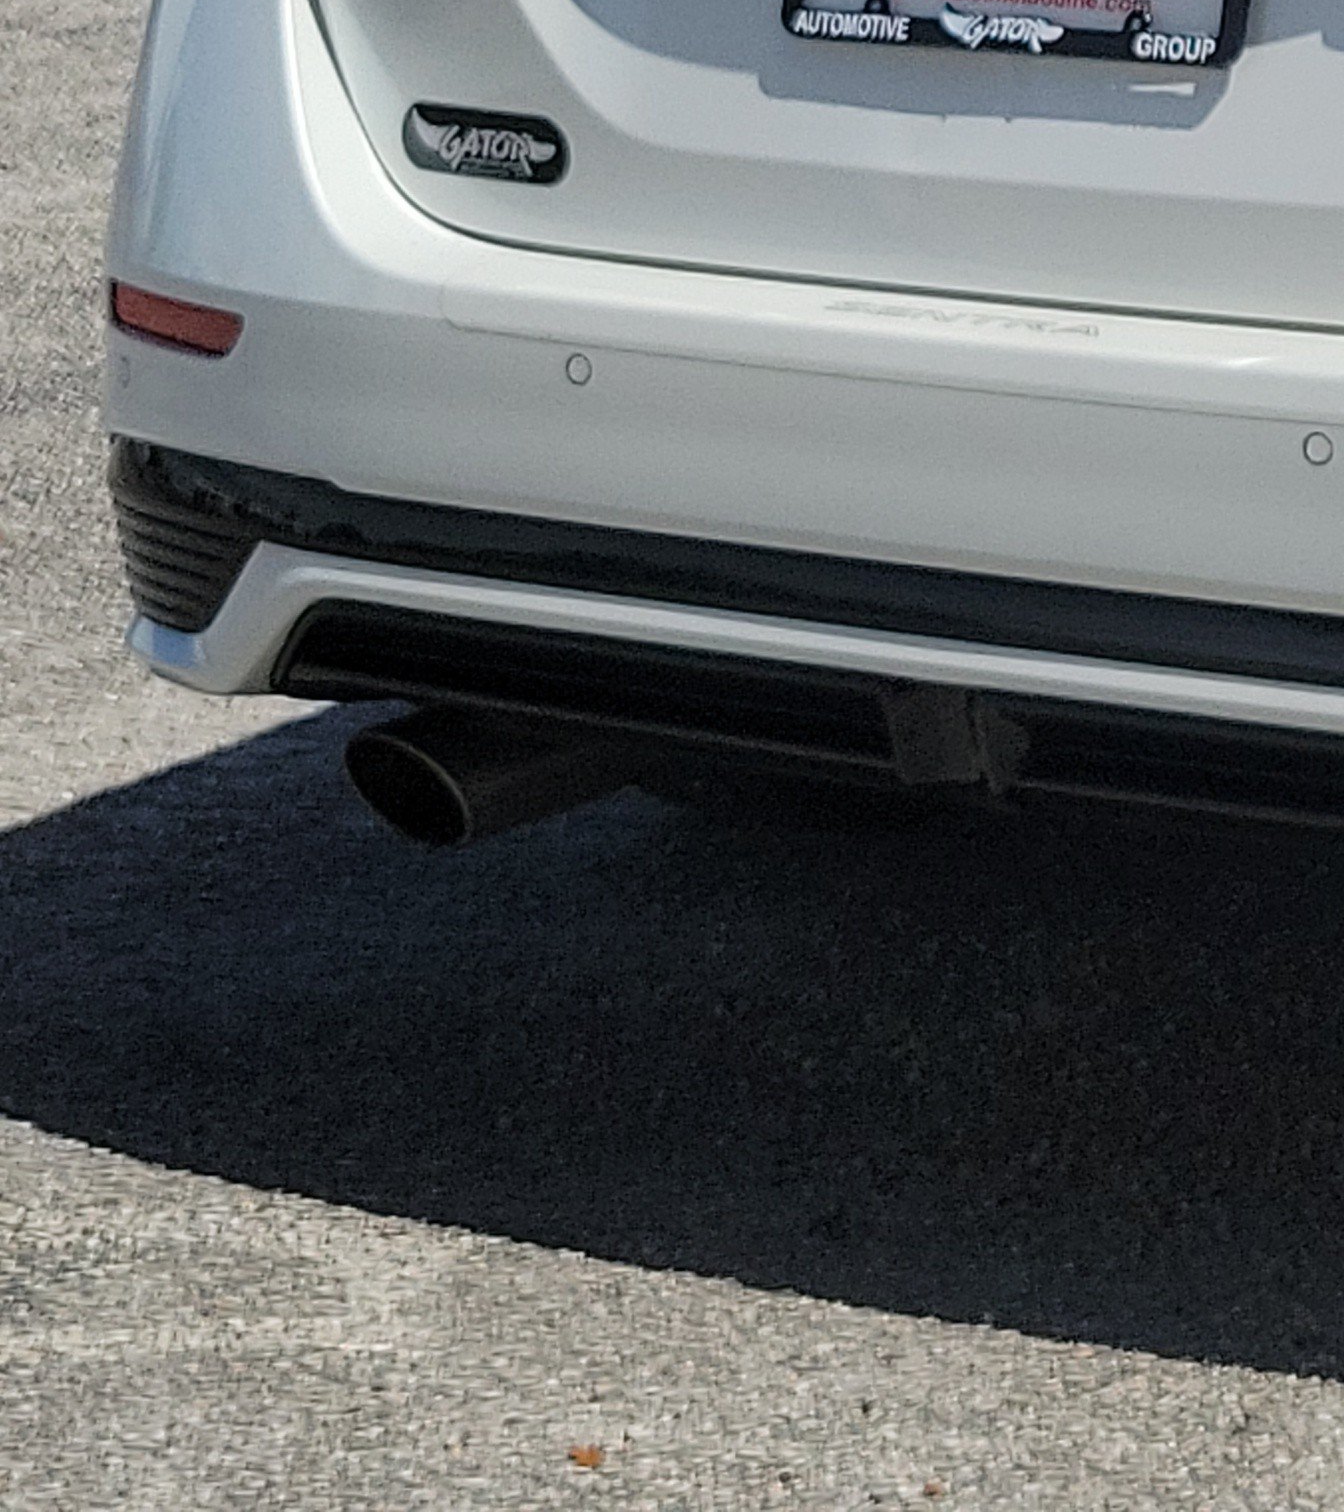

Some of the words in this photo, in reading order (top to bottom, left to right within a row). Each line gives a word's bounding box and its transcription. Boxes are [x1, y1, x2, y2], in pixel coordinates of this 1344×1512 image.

[793, 8, 911, 42] AUTOMOTIVE
[1131, 31, 1218, 65] GROUP
[438, 124, 537, 178] GATOR
